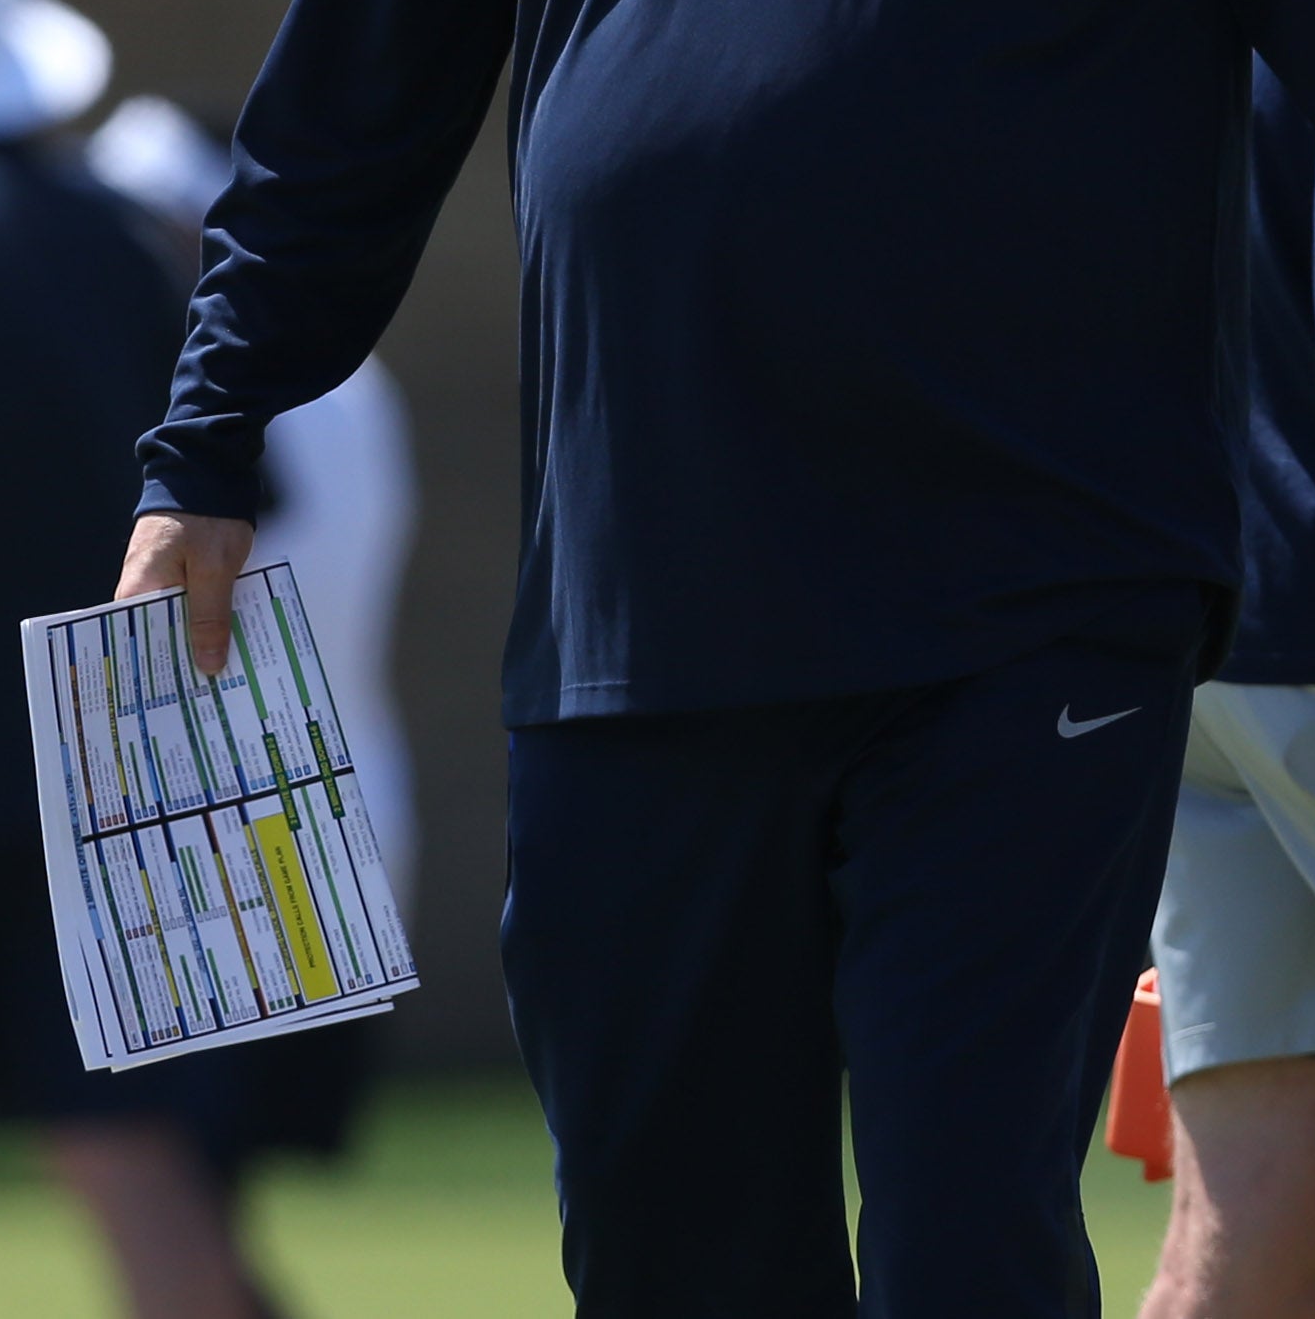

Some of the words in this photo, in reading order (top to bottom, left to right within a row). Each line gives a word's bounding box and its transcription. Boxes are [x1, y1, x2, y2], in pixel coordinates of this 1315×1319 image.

[273, 845, 285, 863] PLAN
[279, 865, 291, 883] GAME
[285, 884, 297, 903] FROM
[291, 904, 304, 925] CALLS
[298, 926, 316, 968] PROTECTION
